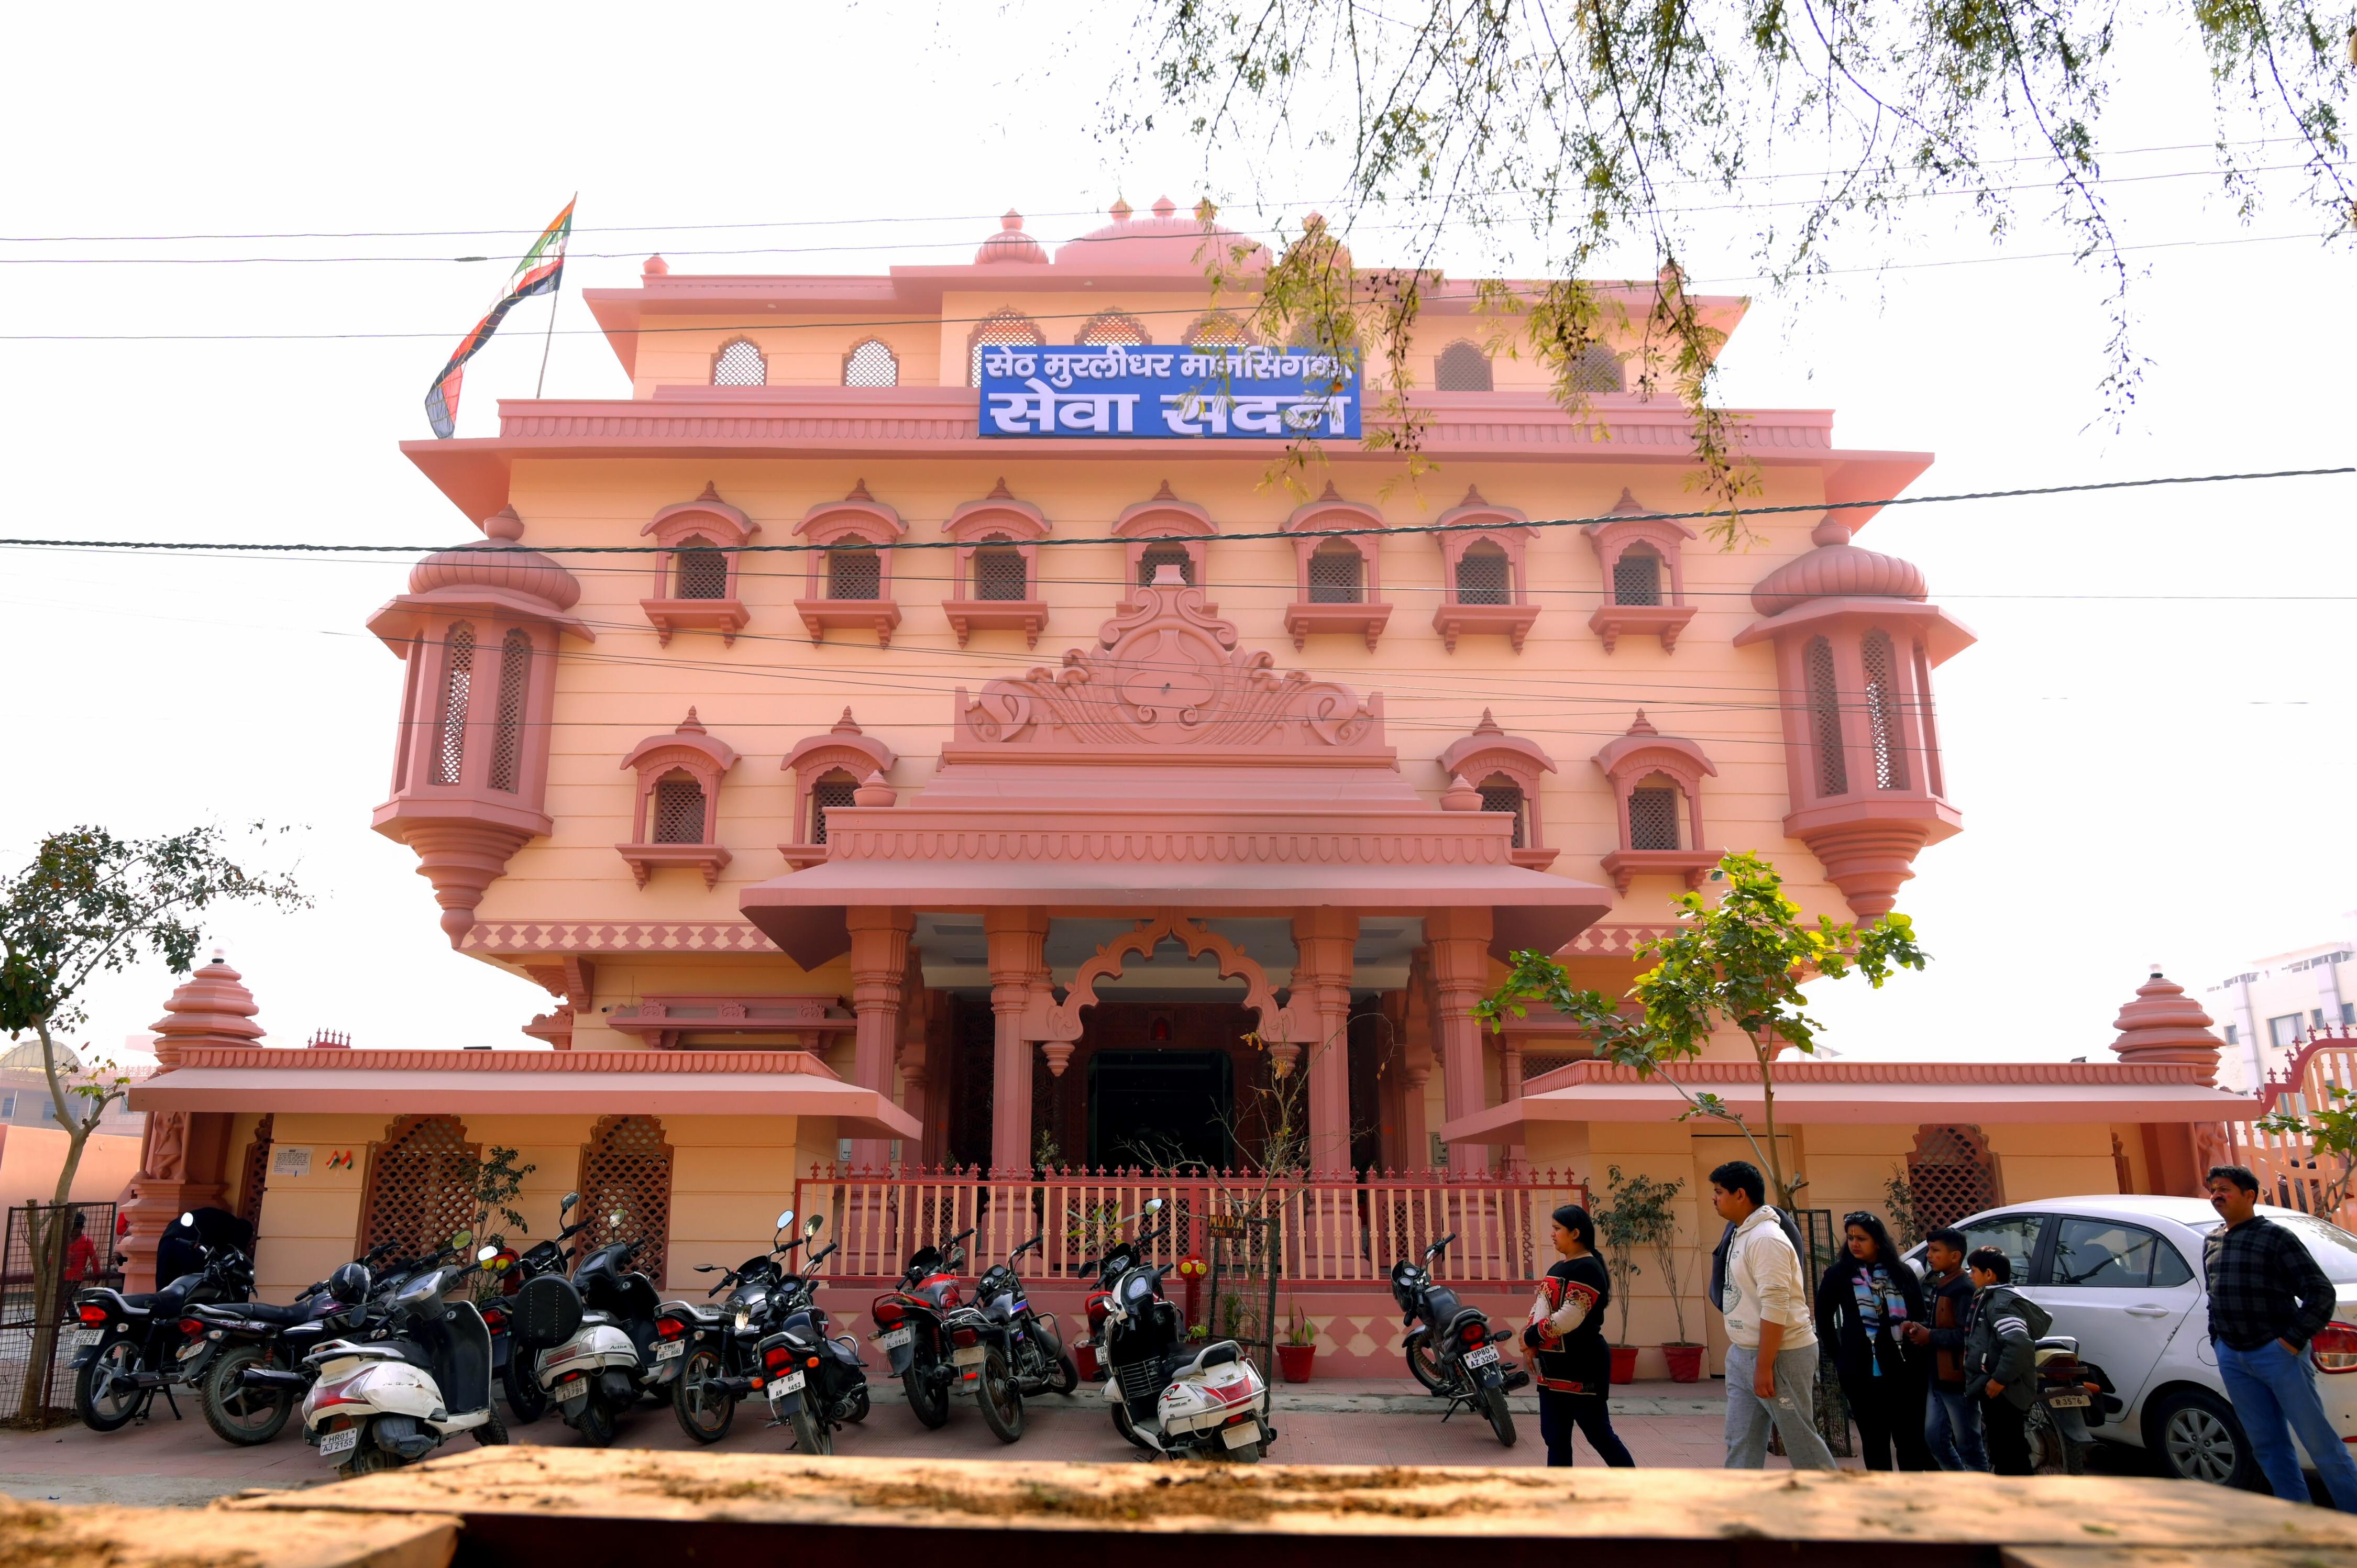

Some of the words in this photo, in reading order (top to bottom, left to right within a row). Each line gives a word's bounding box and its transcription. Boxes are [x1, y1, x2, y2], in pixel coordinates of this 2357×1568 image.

[985, 345, 1038, 378] सेठ
[1043, 345, 1174, 389] मुरलीधर
[988, 377, 1140, 433] सेवा
[1160, 394, 1352, 435] सदन
[1471, 1348, 1490, 1359] UP80
[1470, 1359, 1480, 1368] AZ
[1481, 1353, 1498, 1364] 3204
[788, 1382, 801, 1392] 1452
[328, 1432, 349, 1443] HR01
[322, 1443, 334, 1453] AJ
[335, 1440, 353, 1450] 2155
